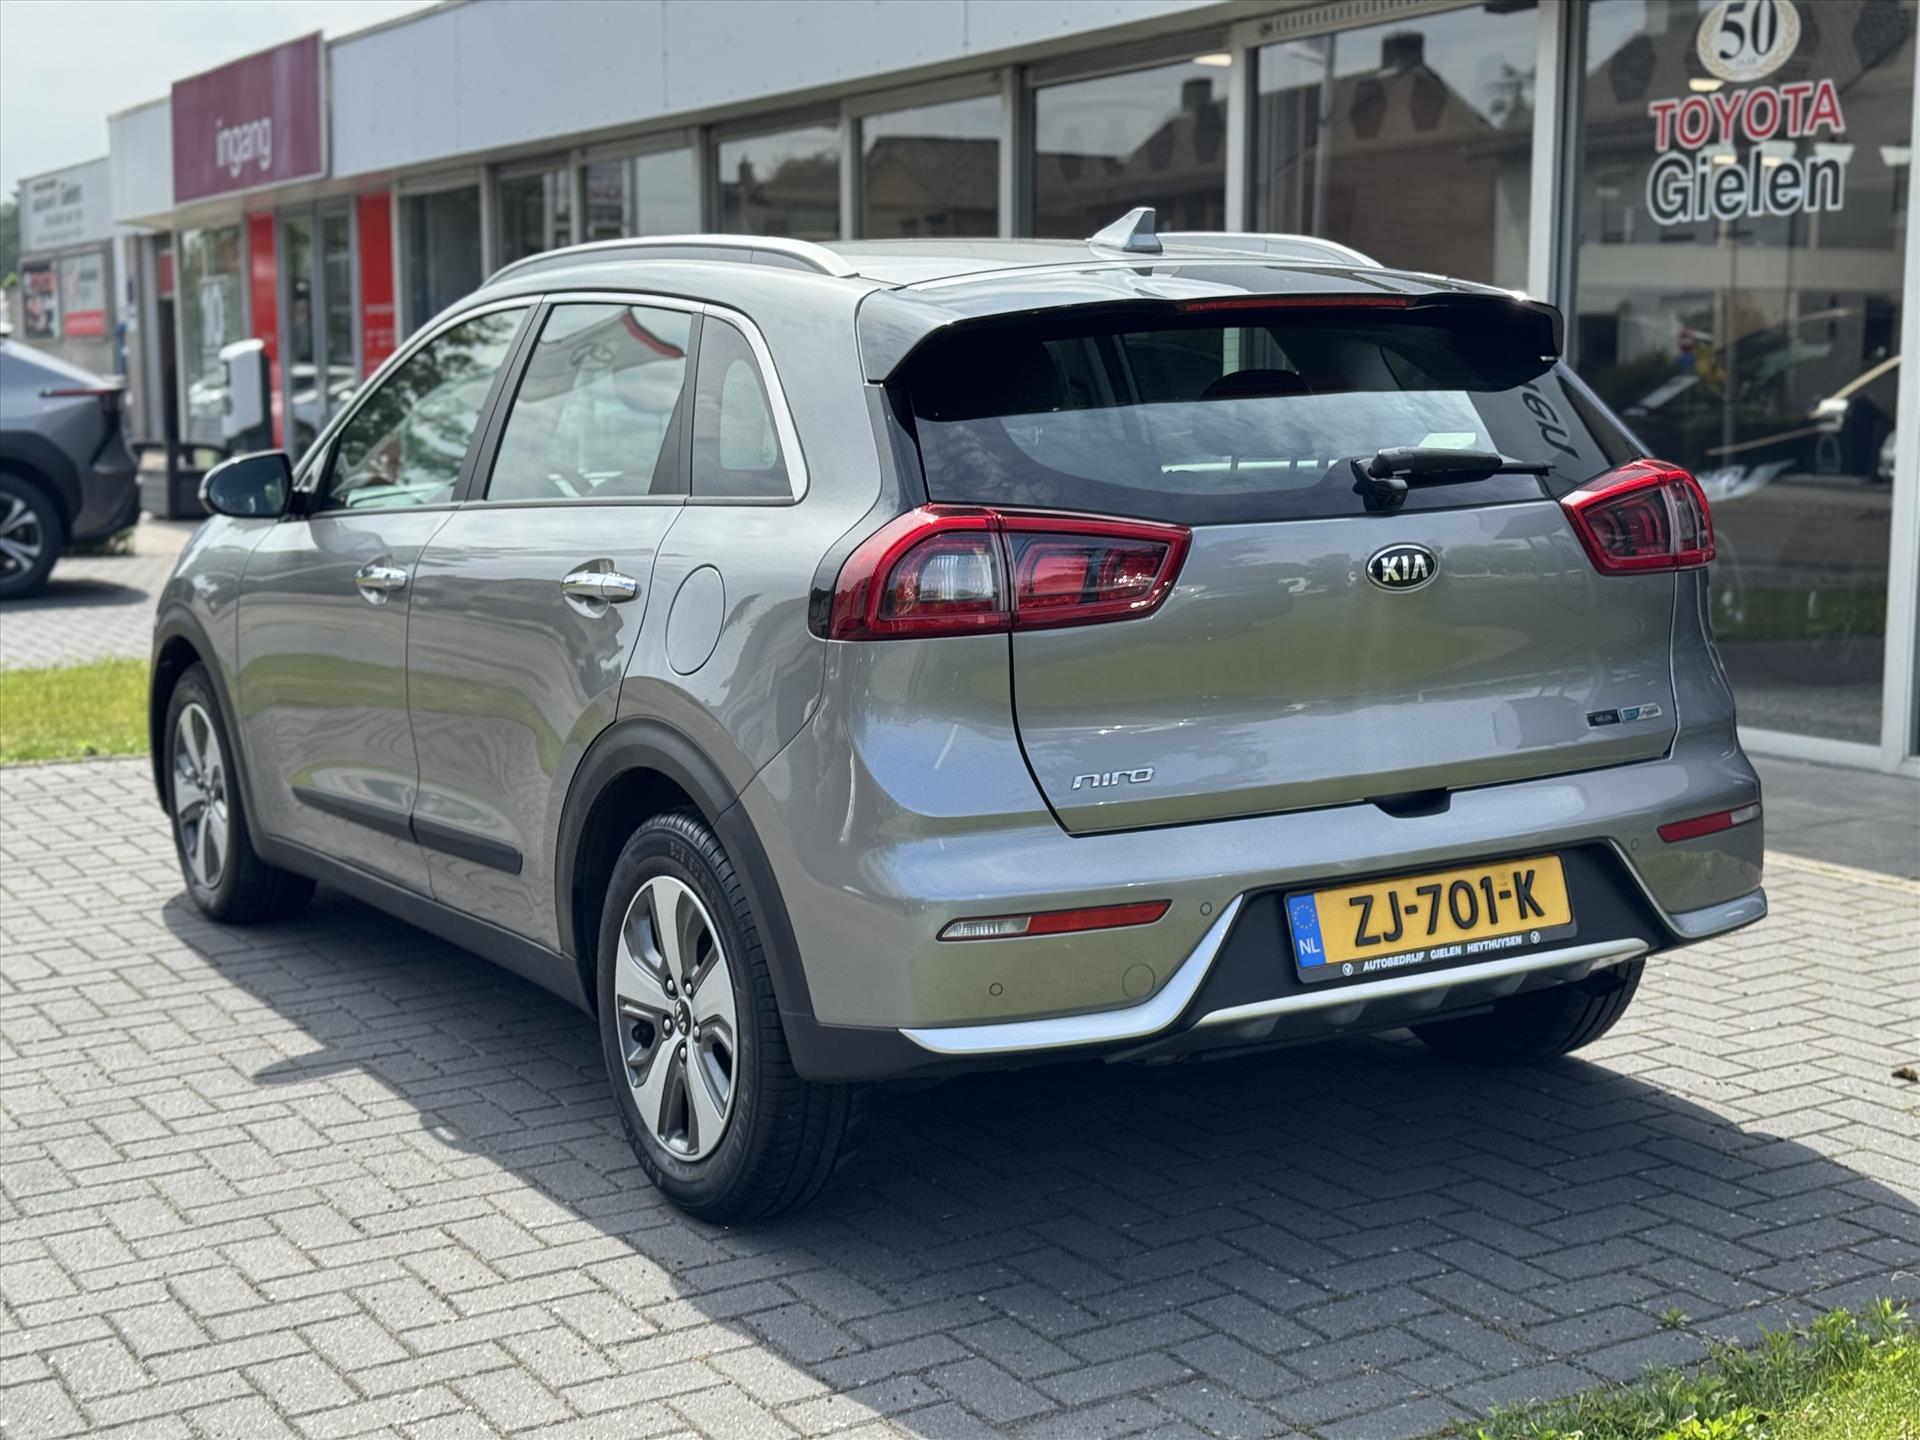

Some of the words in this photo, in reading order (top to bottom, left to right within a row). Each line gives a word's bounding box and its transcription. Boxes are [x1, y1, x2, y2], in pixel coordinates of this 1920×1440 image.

[1718, 0, 1778, 60] 50
[1648, 79, 1845, 153] TOYOTA
[215, 117, 272, 178] ingang
[1647, 146, 1843, 225] Gielen
[1380, 553, 1428, 582] KIA
[1349, 868, 1545, 948] ZJ-701-K
[1299, 937, 1321, 956] NL
[1362, 950, 1425, 972] AUTOBEDRIJF
[1430, 944, 1462, 960] GIELEN
[1466, 935, 1523, 954] HEYTHUYSEN
[675, 1001, 687, 1034] KIA
